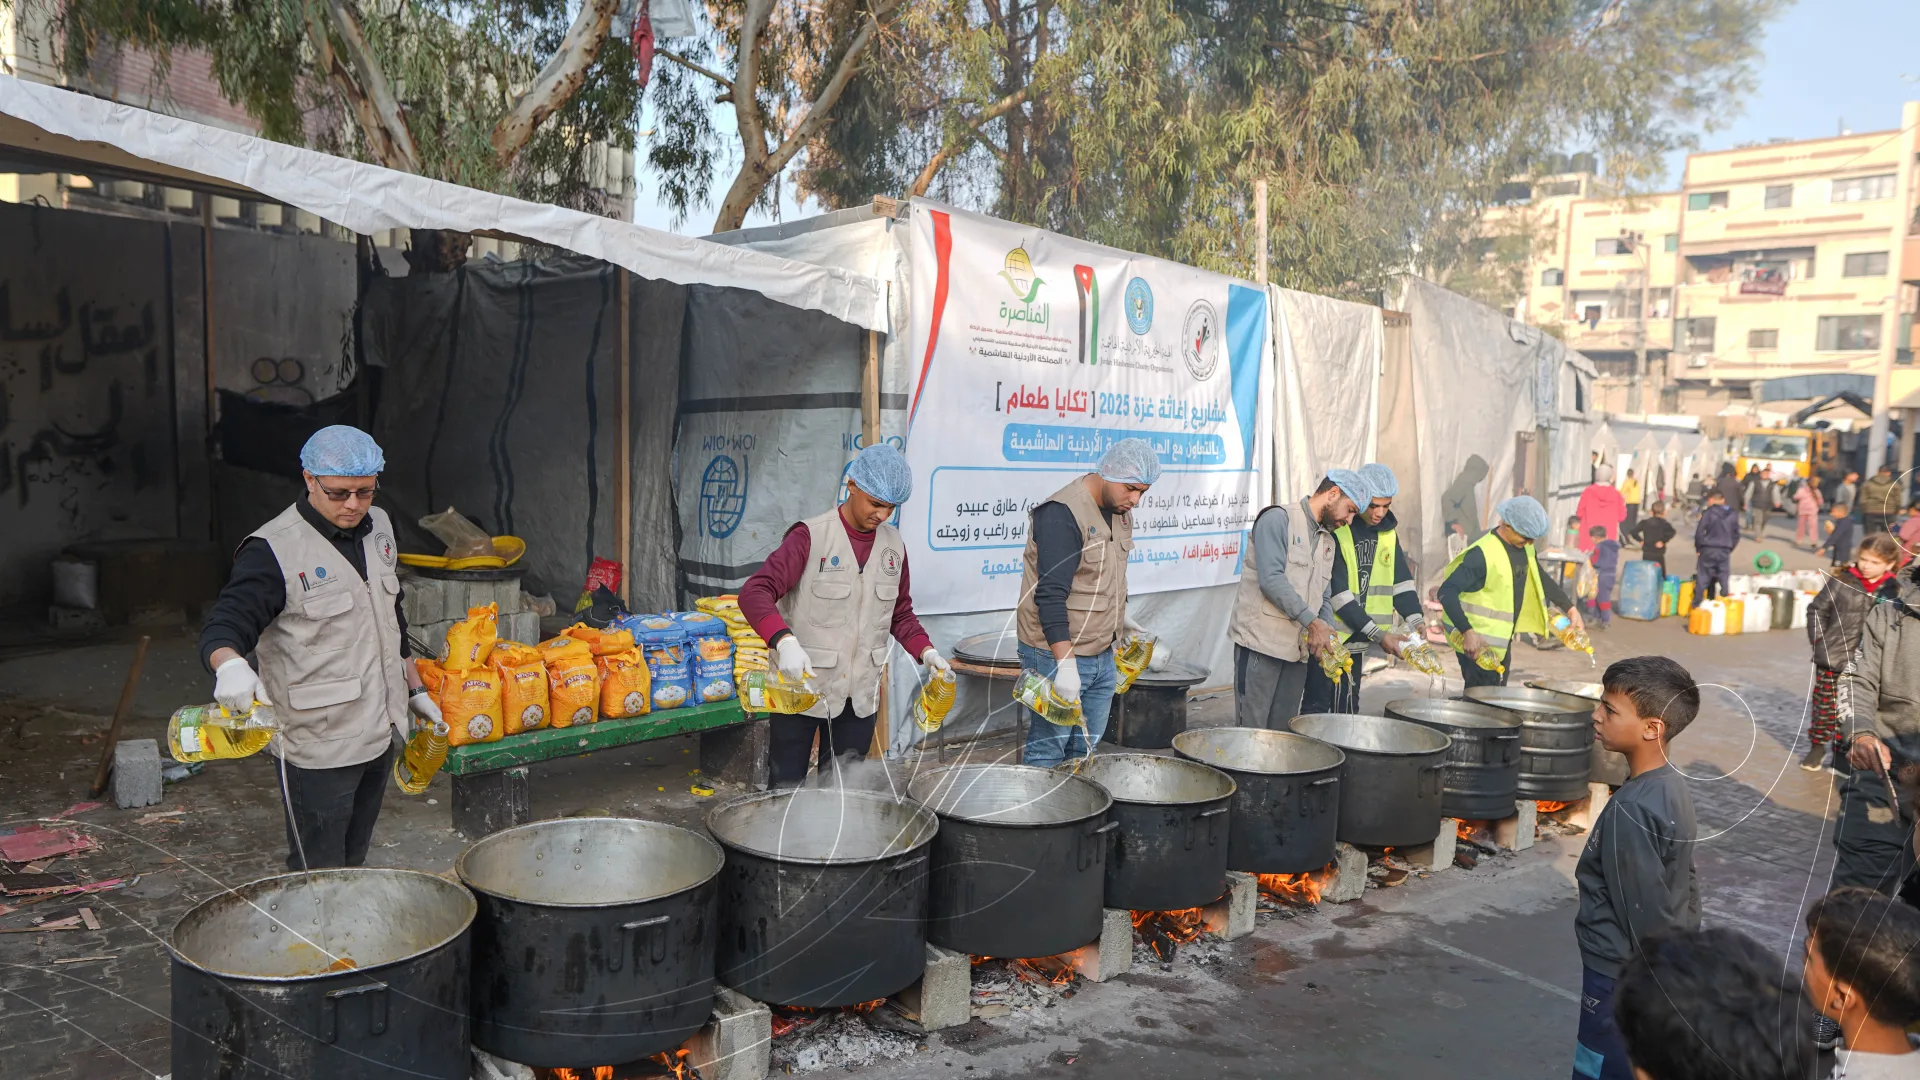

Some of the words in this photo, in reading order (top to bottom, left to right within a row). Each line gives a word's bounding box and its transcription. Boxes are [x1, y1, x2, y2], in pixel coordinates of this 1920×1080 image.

[978, 347, 1013, 359] الهاشمية
[1013, 351, 1037, 362] الأردنية
[1037, 354, 1063, 365] المملكة
[1099, 391, 1129, 417] 2025
[1134, 396, 1155, 423] غزة
[1191, 401, 1228, 430] مشاريع
[1010, 429, 1064, 455] الهاشمية
[1067, 428, 1103, 457] الأردنية
[1185, 438, 1219, 461] بالتعاون
[1171, 444, 1184, 461] مع
[956, 501, 989, 517] عبيدو
[992, 498, 1017, 517] طارق
[1148, 496, 1153, 508] 9
[1182, 495, 1191, 507] 12
[1194, 495, 1218, 510] ضرغام
[1227, 493, 1239, 508] خير
[936, 524, 970, 542] زوجته
[973, 527, 980, 541] و
[983, 522, 1008, 541] راغب
[1011, 522, 1025, 540] ابو
[1147, 547, 1180, 566] جمعية
[1221, 541, 1239, 559] تنفيذ
